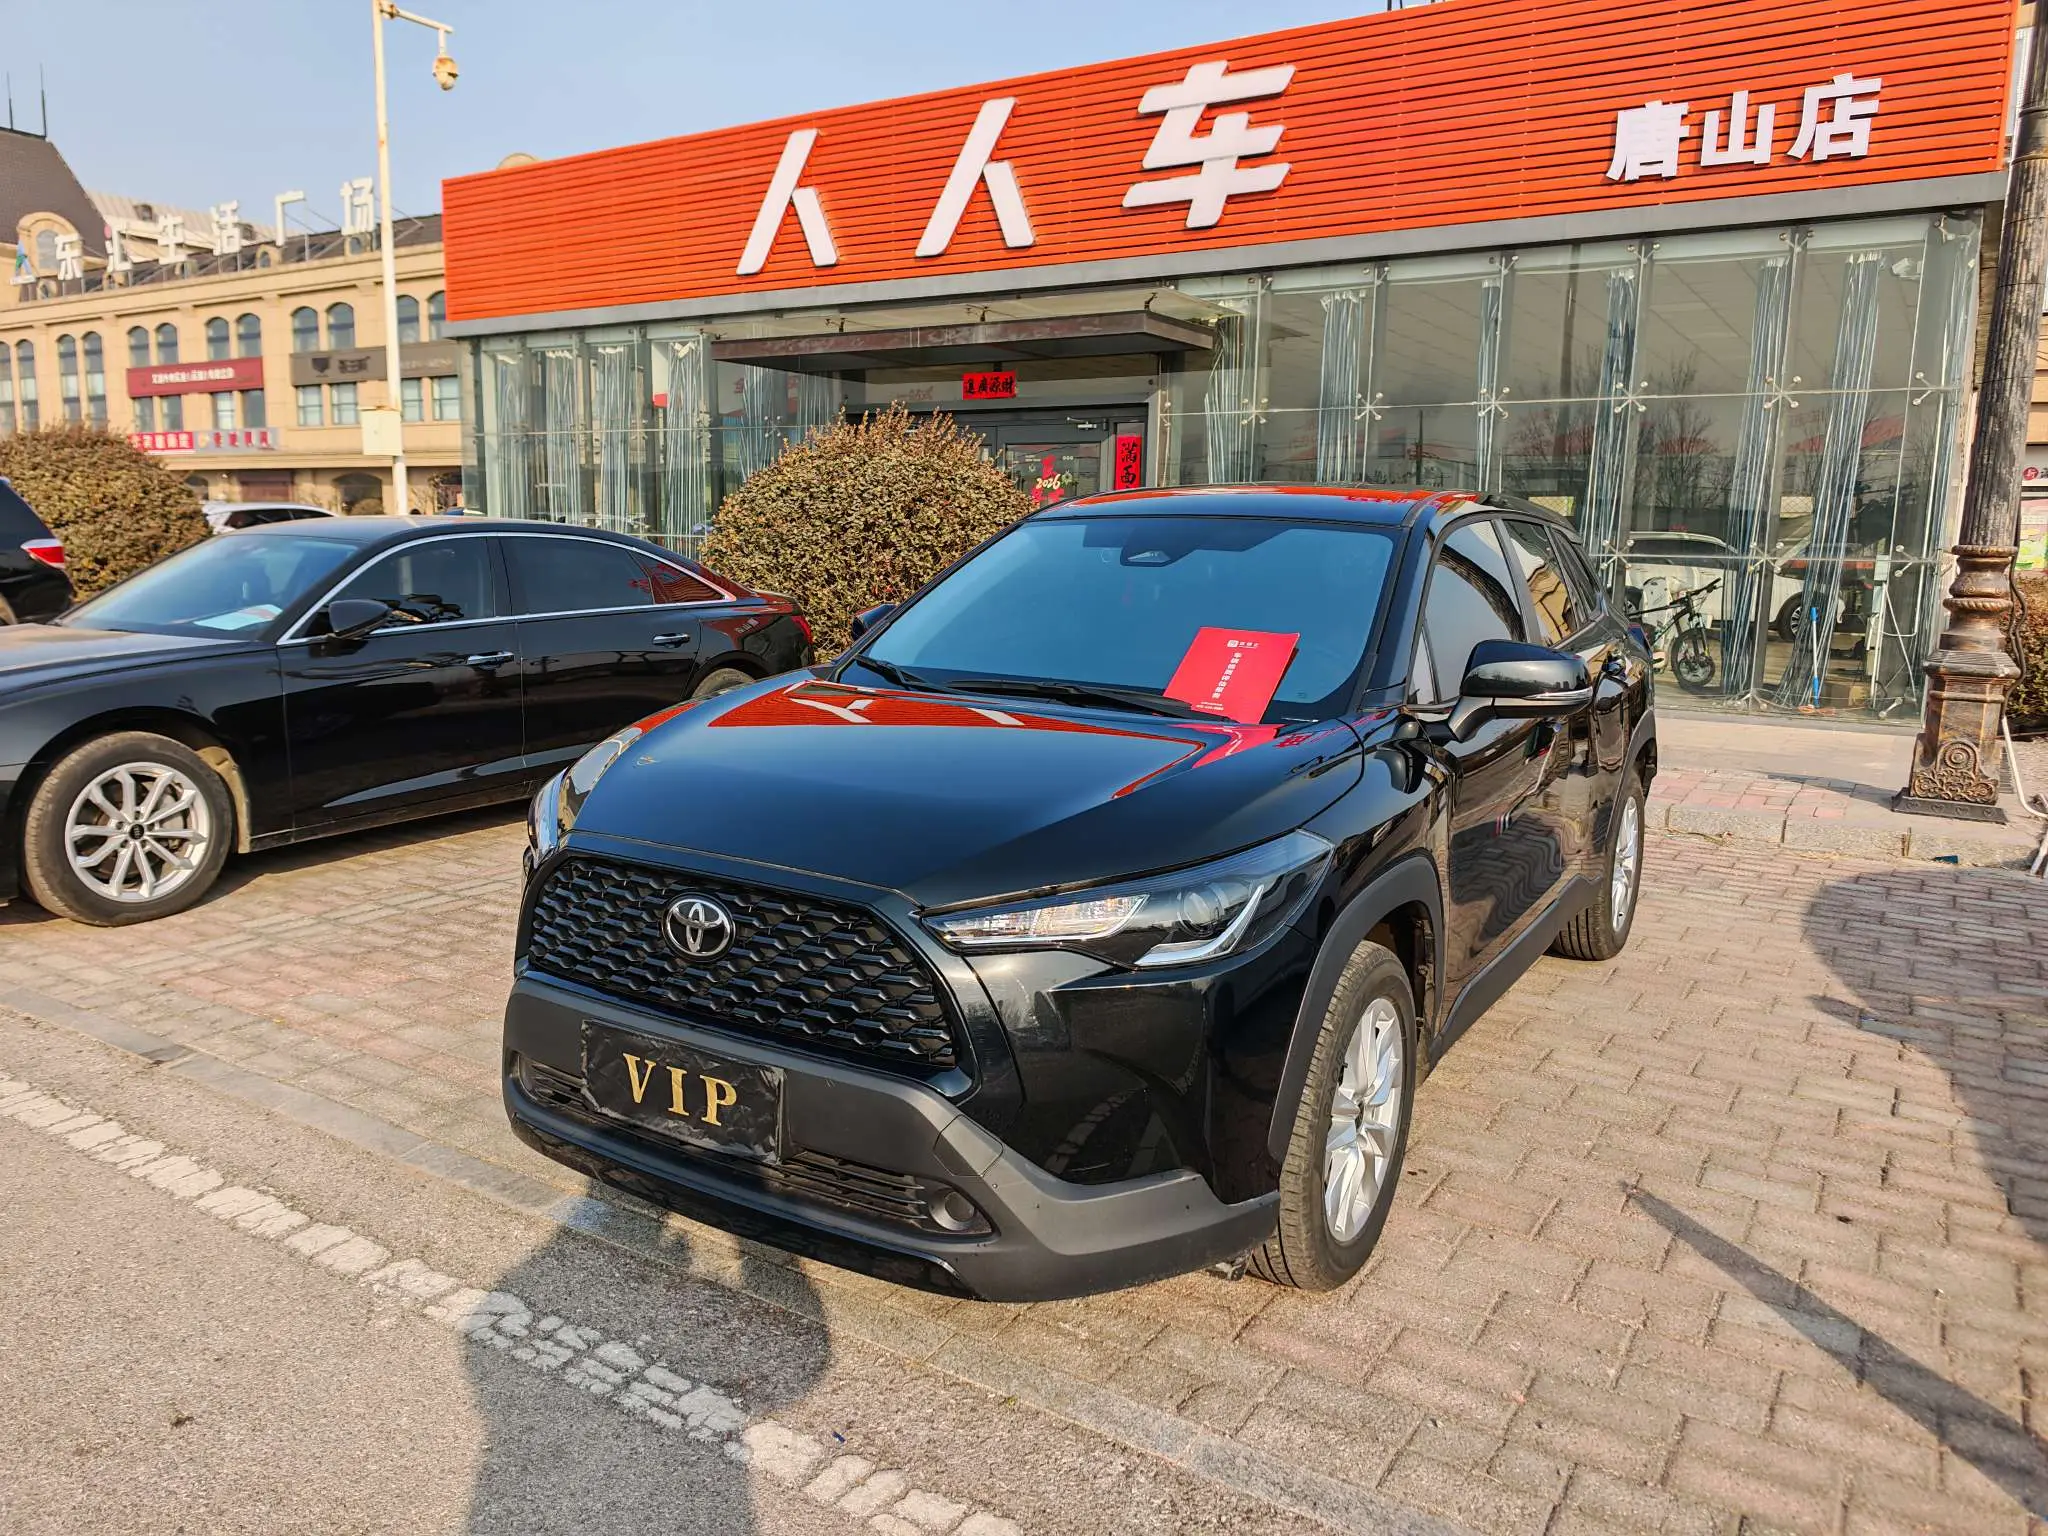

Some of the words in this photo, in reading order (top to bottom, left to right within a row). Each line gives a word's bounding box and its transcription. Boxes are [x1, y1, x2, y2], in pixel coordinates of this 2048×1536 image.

[735, 58, 1297, 276] 人人车
[1605, 71, 1883, 182] 唐山店
[1035, 473, 1061, 490] 2026
[622, 1052, 737, 1127] VIP
